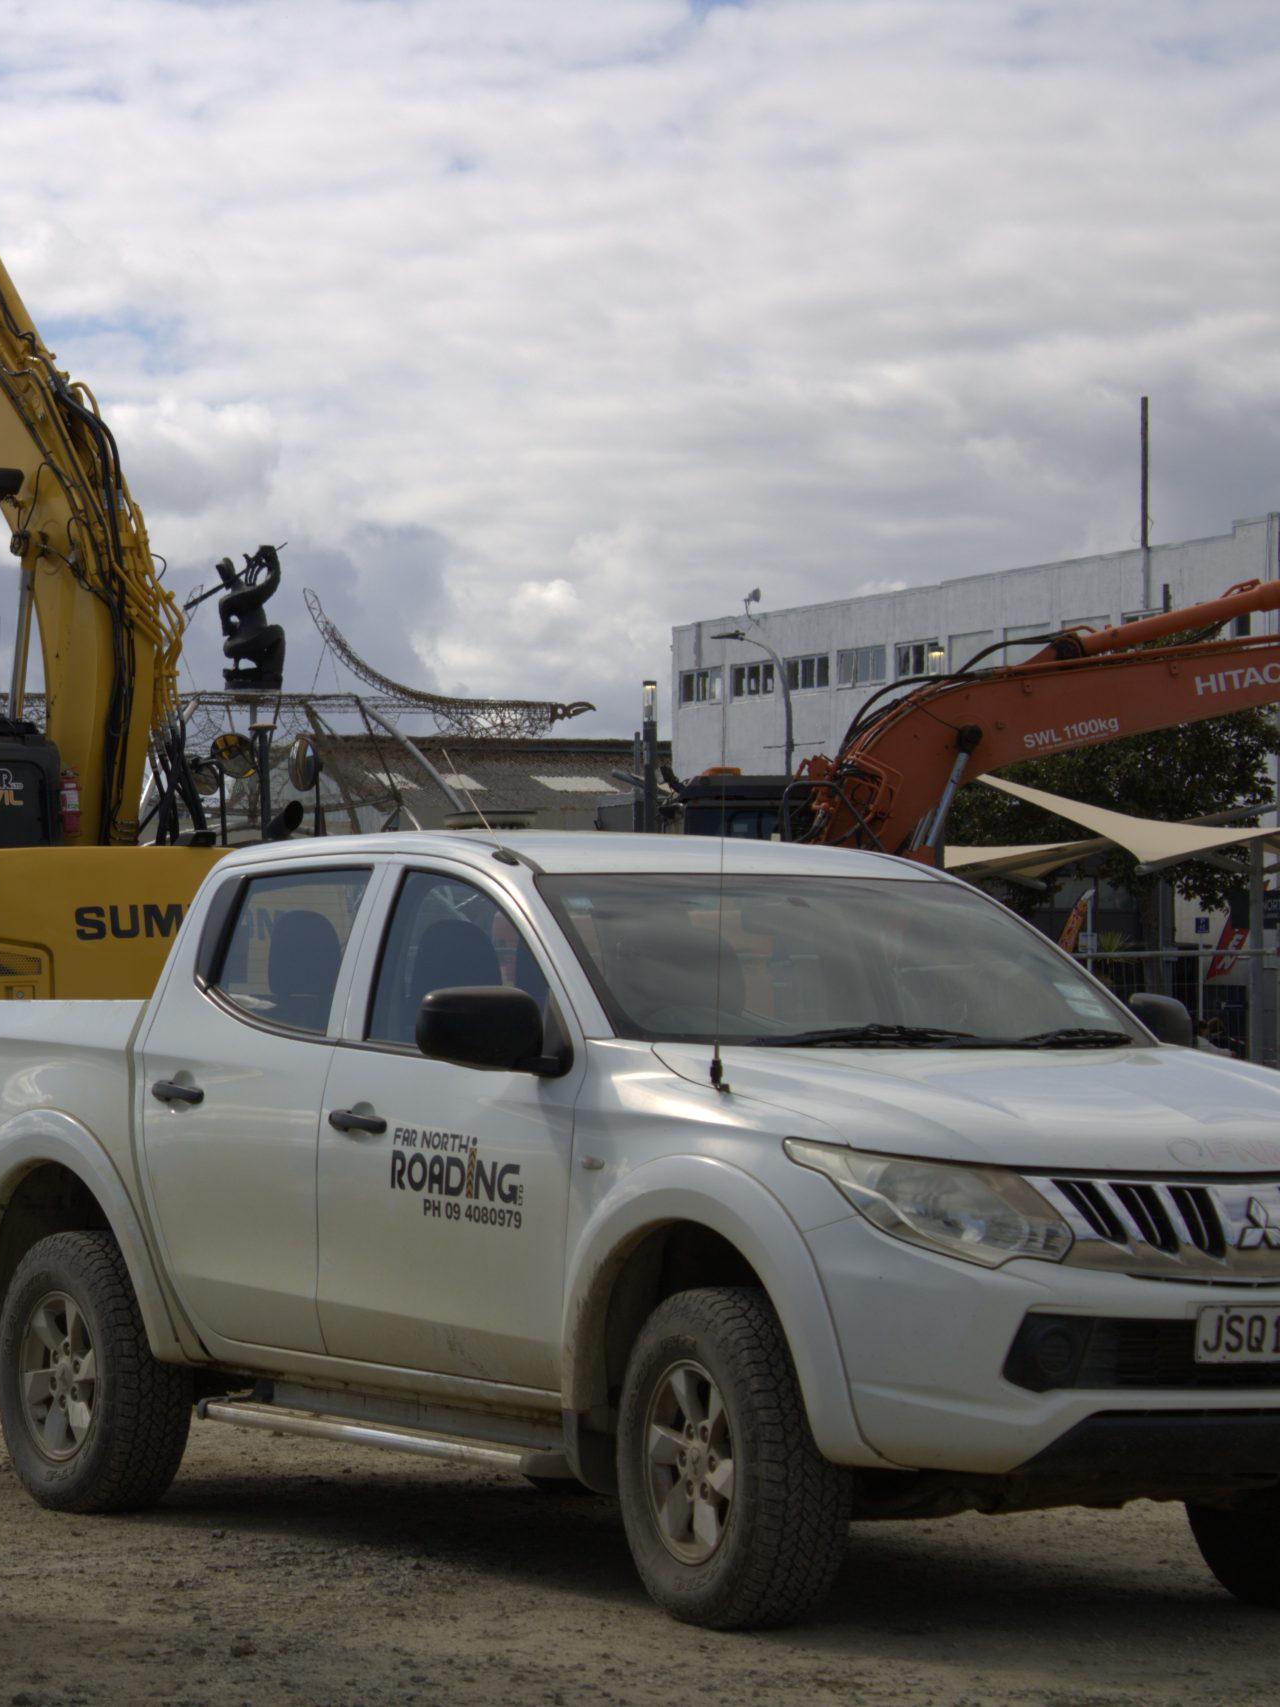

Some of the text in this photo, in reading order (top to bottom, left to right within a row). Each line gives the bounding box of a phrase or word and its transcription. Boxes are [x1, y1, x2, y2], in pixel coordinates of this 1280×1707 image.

[1023, 728, 1062, 748] SWL
[1063, 717, 1119, 740] 1100kg
[74, 903, 190, 941] SUM
[392, 1127, 470, 1153] FAR NORTH
[423, 1199, 523, 1229] PH 09 4080979
